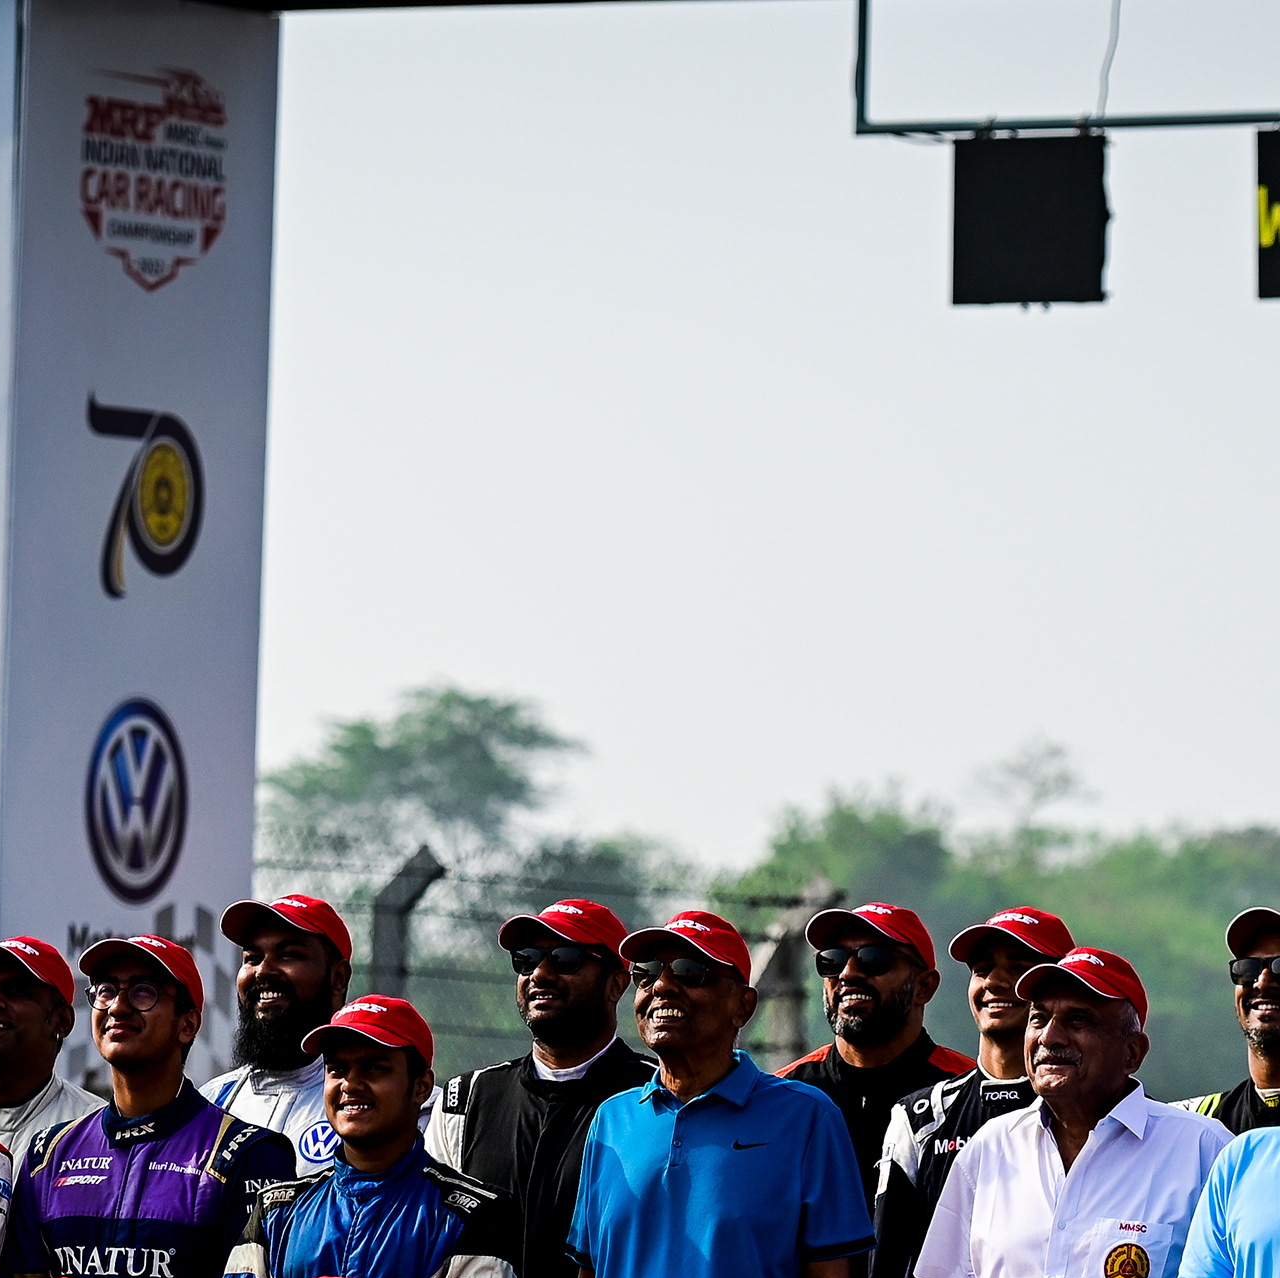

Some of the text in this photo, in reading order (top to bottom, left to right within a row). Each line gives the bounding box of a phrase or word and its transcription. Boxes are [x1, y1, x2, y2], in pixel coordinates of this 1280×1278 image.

[81, 138, 226, 182] INDIAN NATIONAL
[80, 167, 227, 222] CAR RACING
[984, 1091, 1020, 1101] TORQ
[935, 1137, 971, 1153] Mob
[60, 1158, 112, 1172] INATUR
[245, 1179, 280, 1192] INA
[264, 1190, 294, 1206] OMP
[447, 1192, 477, 1209] OMP
[1119, 1223, 1147, 1233] MMSC
